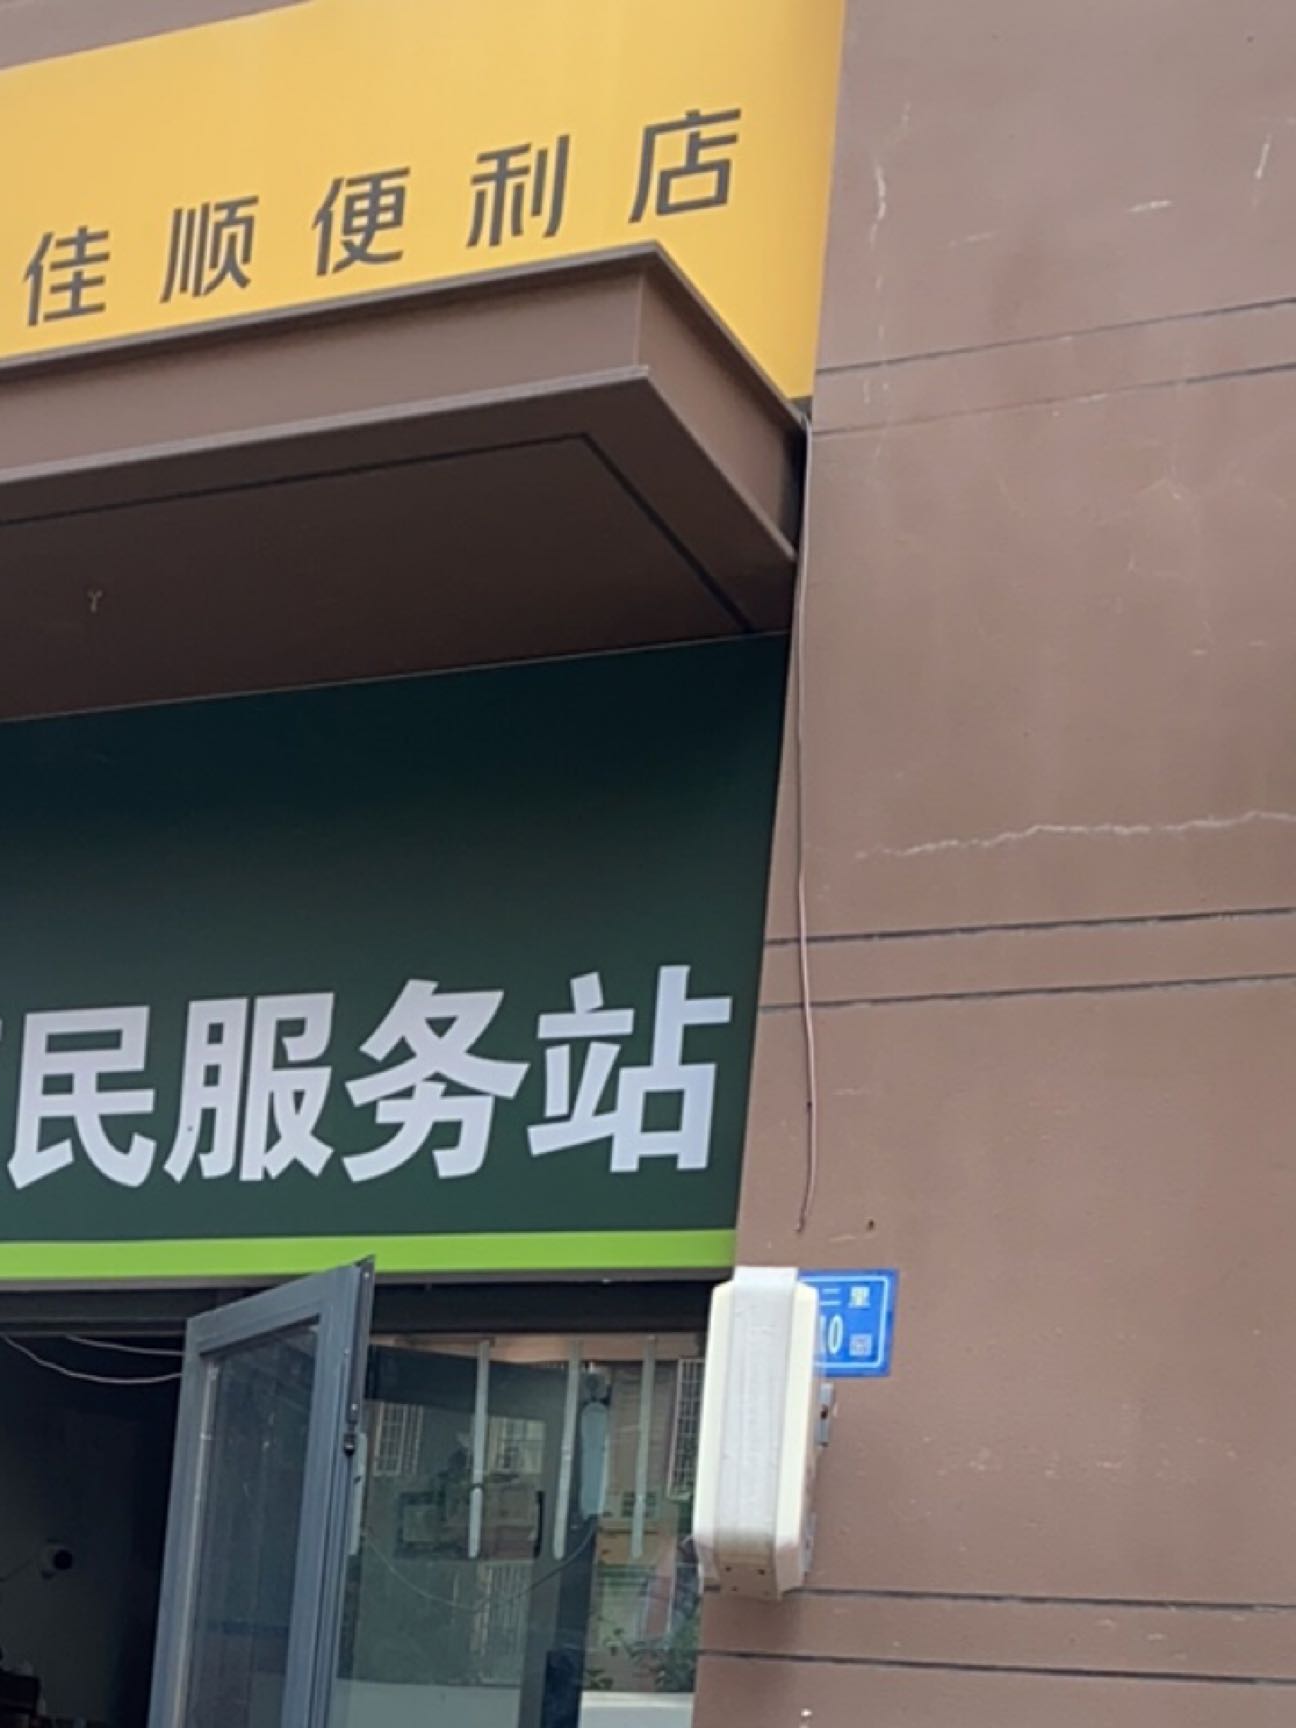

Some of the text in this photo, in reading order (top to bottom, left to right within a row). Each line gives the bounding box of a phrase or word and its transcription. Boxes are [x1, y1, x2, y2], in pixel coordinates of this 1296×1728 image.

[21, 107, 742, 327] 佳顺便利店
